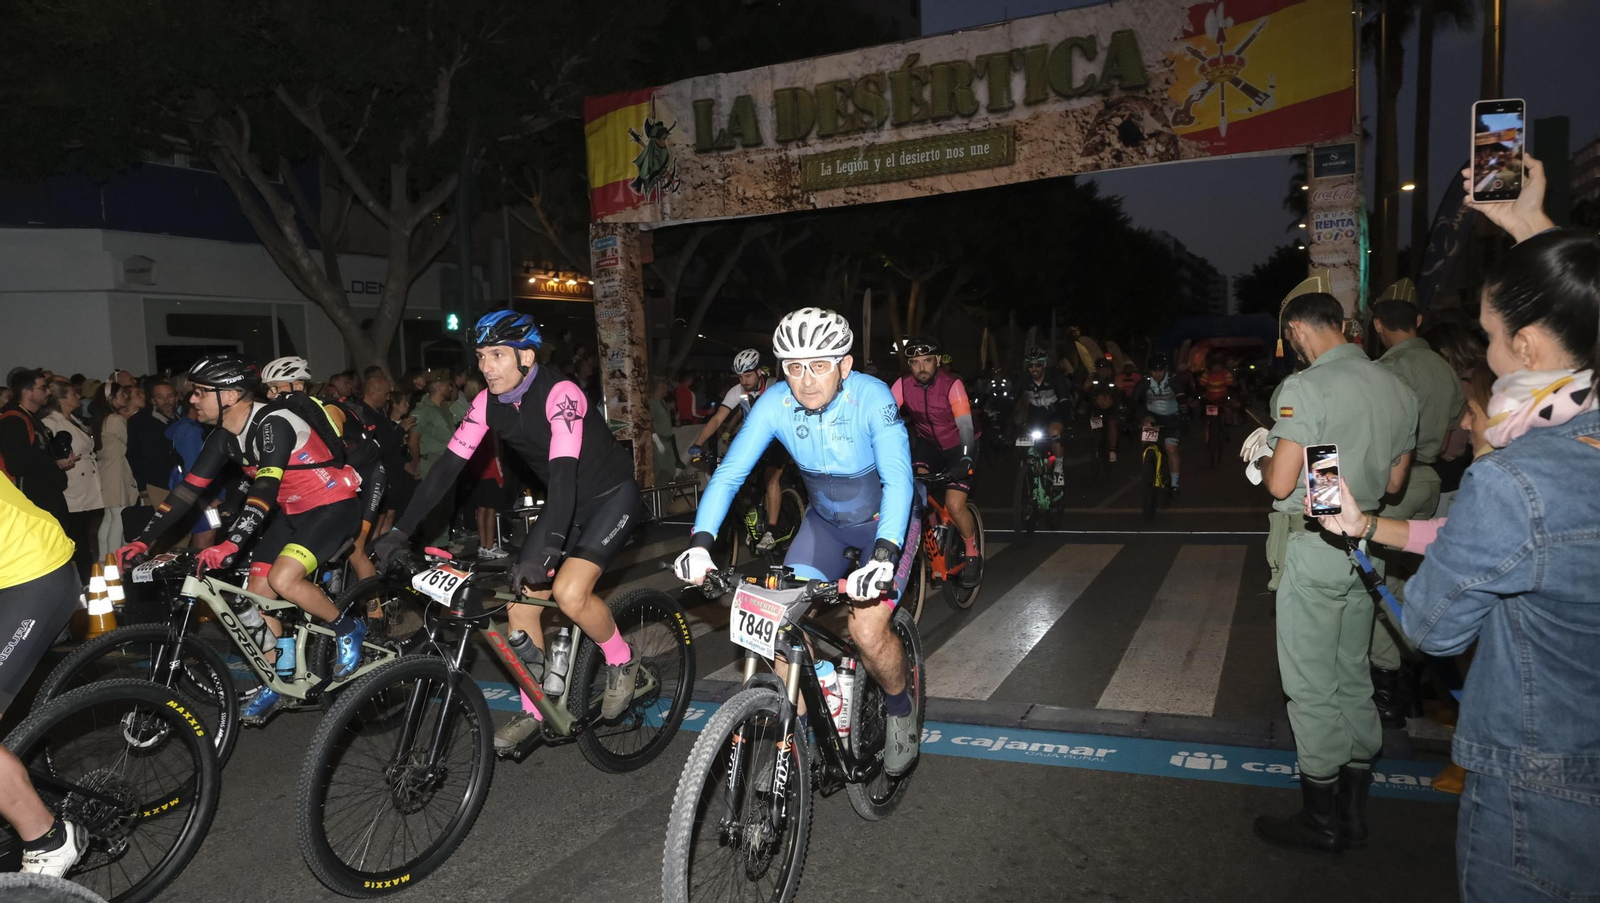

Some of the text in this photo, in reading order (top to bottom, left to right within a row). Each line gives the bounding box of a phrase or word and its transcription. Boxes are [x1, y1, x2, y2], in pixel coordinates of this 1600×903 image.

[693, 28, 1150, 154] LA DESÉRTICA
[820, 142, 990, 176] La Legión y el desierto nos une
[1315, 211, 1354, 219] GRUPO
[1315, 218, 1355, 229] RENTA
[421, 569, 459, 592] 7619
[895, 557, 912, 580] Club
[673, 611, 692, 646] MAXXIS
[739, 609, 774, 643] 7849
[220, 612, 275, 683] ORBEA
[488, 631, 545, 702] ORBEA
[165, 698, 206, 739] MAXXIS
[950, 736, 1117, 757] cajamar
[1062, 754, 1108, 763] RURAL
[364, 873, 411, 889] MAXXIS
